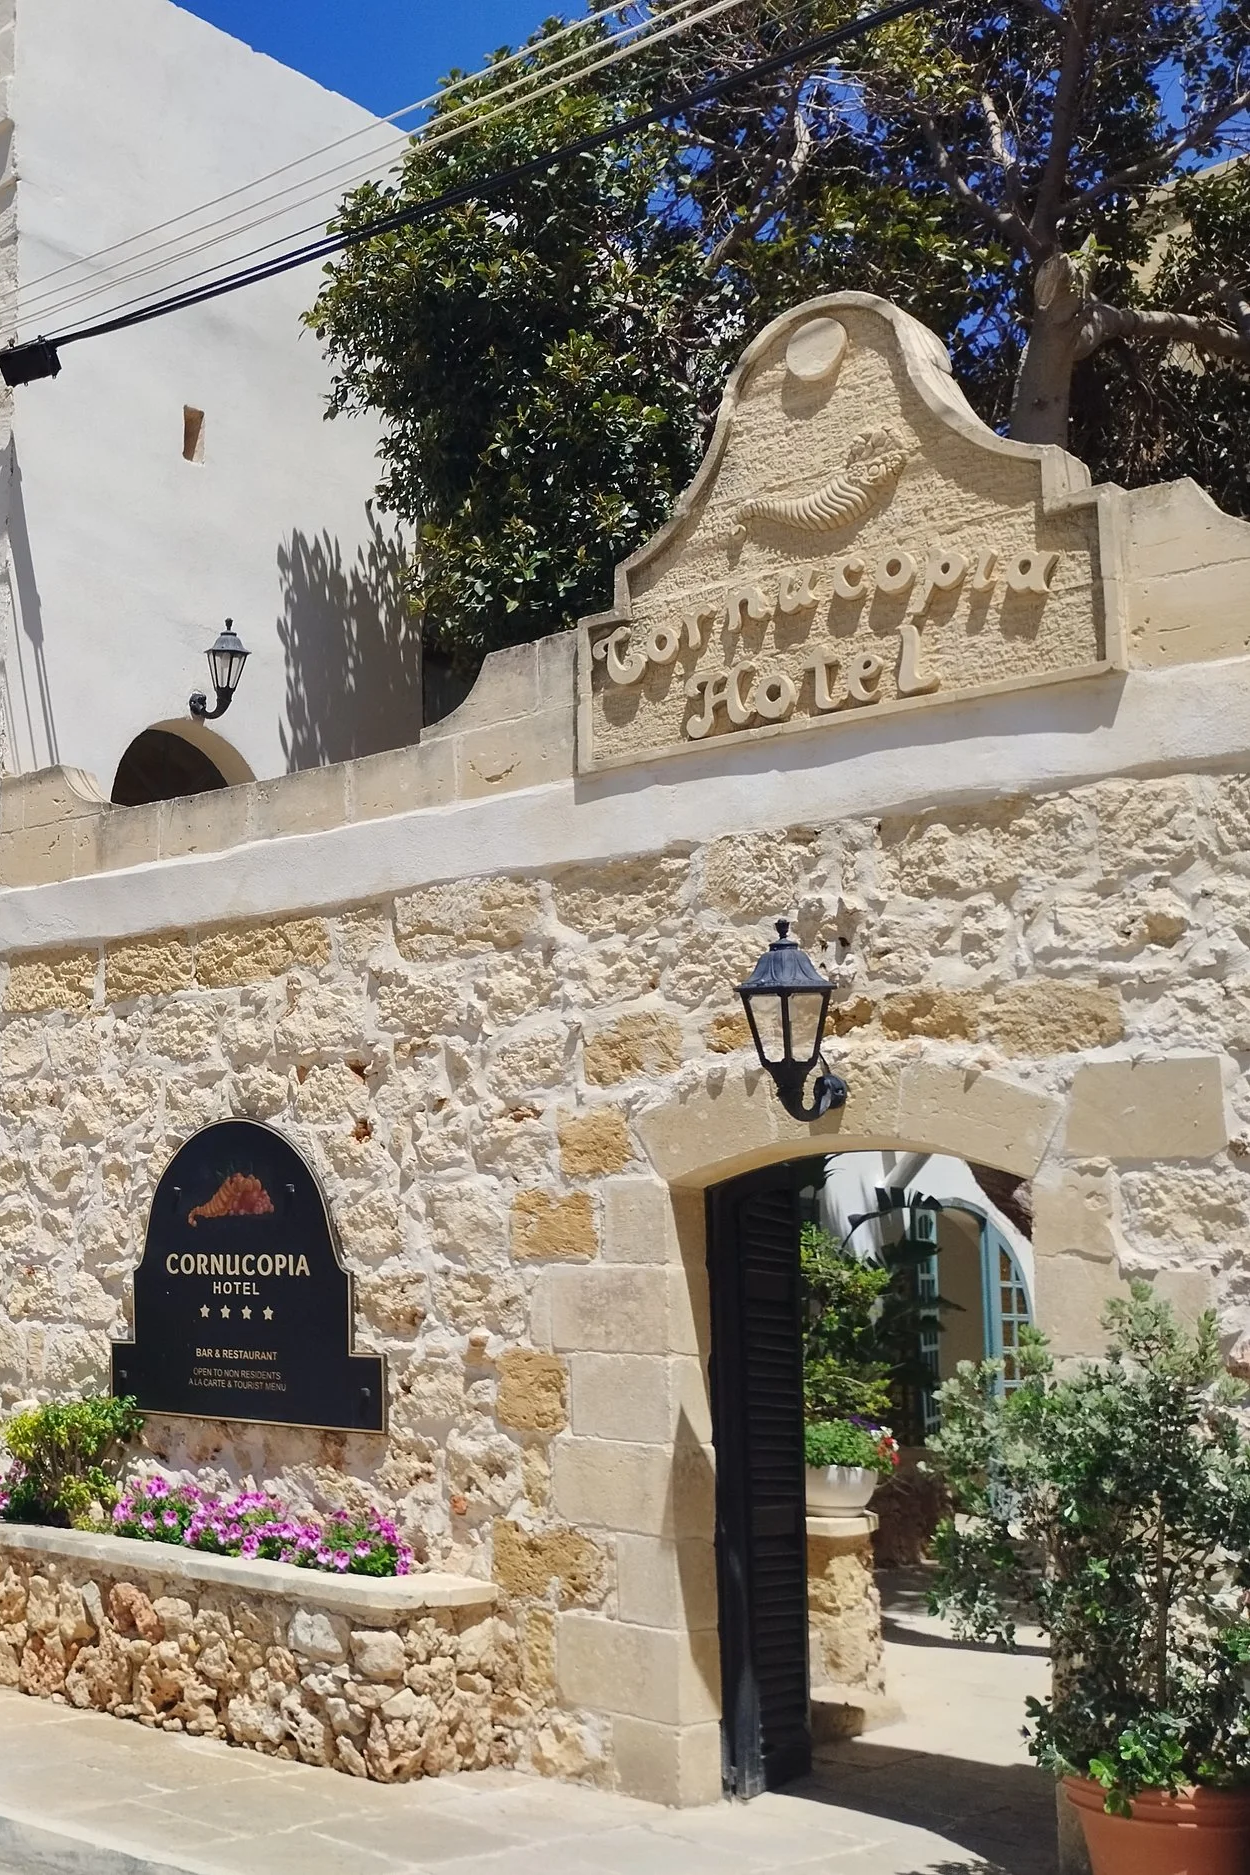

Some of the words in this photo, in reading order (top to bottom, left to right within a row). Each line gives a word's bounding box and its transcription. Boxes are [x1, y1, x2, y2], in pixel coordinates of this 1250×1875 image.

[592, 548, 1060, 685] Cornucopia
[686, 624, 942, 740] Hotel
[165, 1253, 311, 1276] CORNUCOPIA
[213, 1281, 260, 1295] HOTEL
[195, 1347, 213, 1358] BAR
[214, 1349, 221, 1358] &
[222, 1349, 278, 1360] RESTAURANT
[193, 1367, 212, 1376] OPEN
[213, 1368, 223, 1377] TO
[224, 1369, 240, 1378] NON
[240, 1370, 281, 1380] RESIDENTS
[203, 1378, 226, 1388] CARTE
[227, 1380, 233, 1388] &
[234, 1380, 263, 1390] TOURIST
[264, 1382, 287, 1392] MENU
